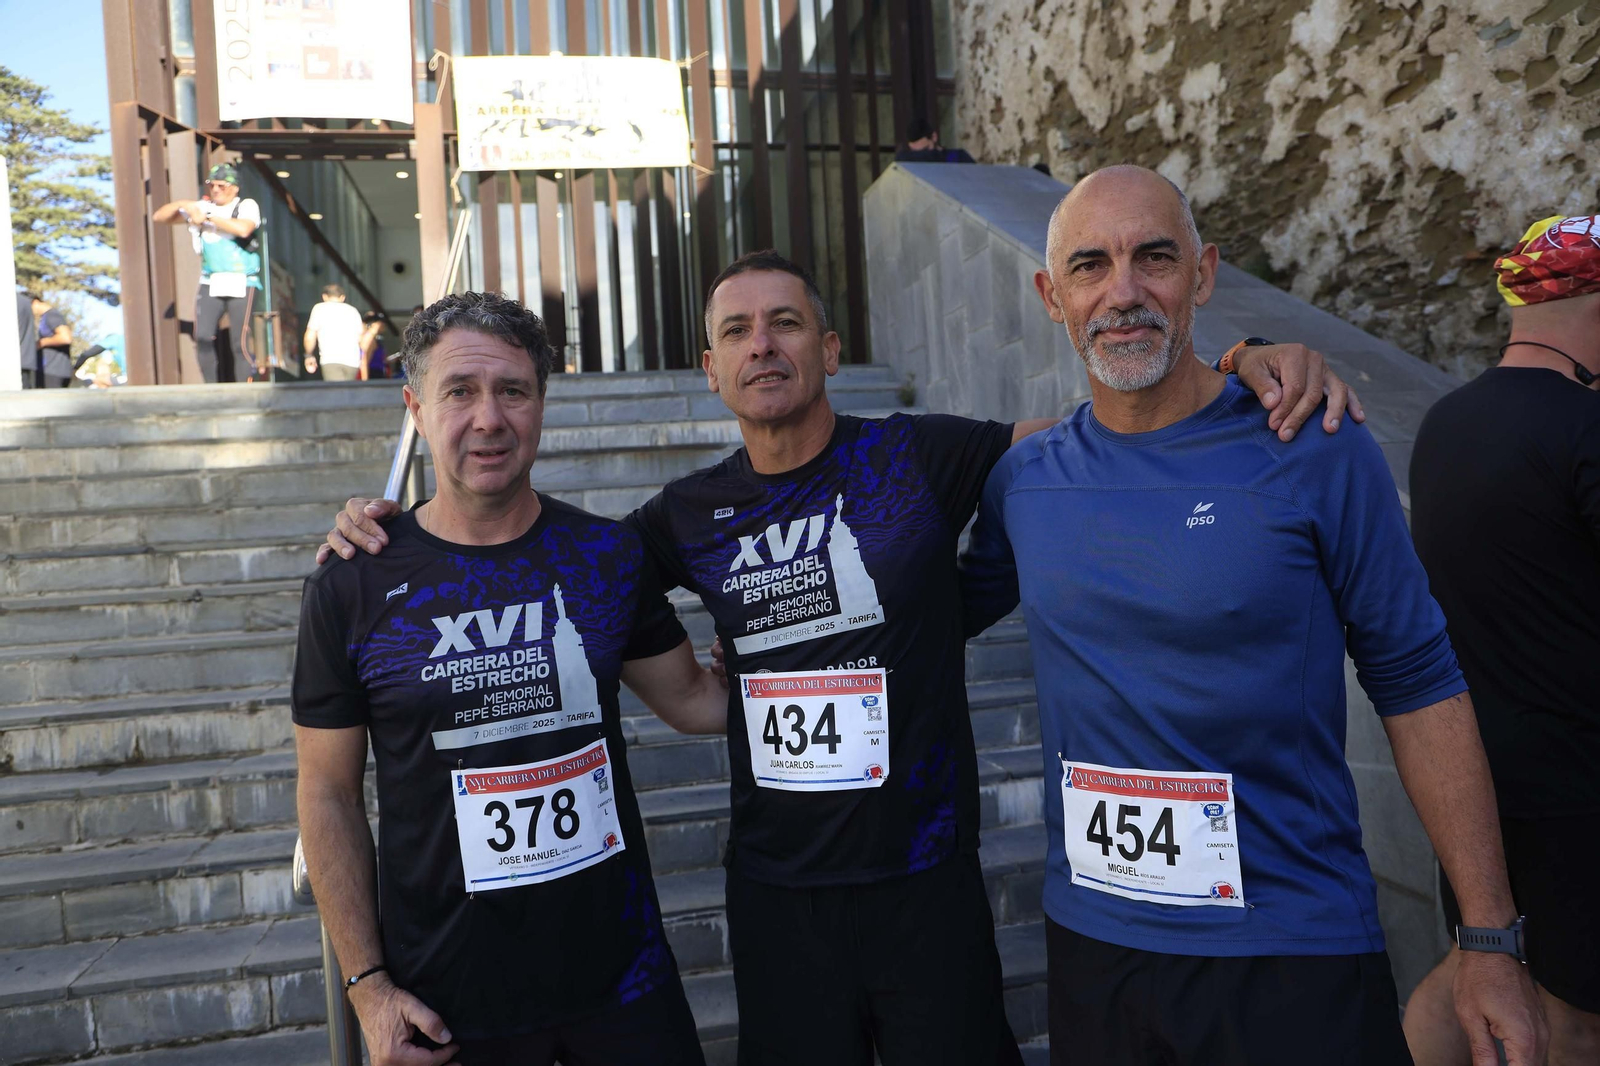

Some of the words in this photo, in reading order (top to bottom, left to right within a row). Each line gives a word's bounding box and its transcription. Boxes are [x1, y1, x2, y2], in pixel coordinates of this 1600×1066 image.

[729, 513, 826, 573] XVI
[722, 567, 791, 594] CARRERA
[793, 554, 825, 575] DEL
[743, 570, 827, 605] ESTRECHO
[746, 615, 775, 632] PEPE
[778, 601, 833, 624] SERRANO
[769, 589, 831, 615] MEMORIAL
[428, 601, 543, 659] XVI
[763, 637, 768, 645] 7
[771, 627, 812, 644] DICIEMBRE
[814, 621, 835, 633] 2025
[847, 612, 877, 625] TARIFA
[421, 652, 512, 682] CARRERA
[513, 646, 548, 667] DEL
[451, 662, 550, 694] ESTRECHO
[483, 683, 553, 706] MEMORIAL
[762, 679, 801, 691] CARRERA
[803, 679, 823, 689] DEL
[824, 677, 880, 688] ESTRECHO
[455, 706, 489, 724] PEPE
[491, 695, 554, 717] SERRANO
[473, 731, 479, 740] 7
[482, 721, 530, 738] DICIEMBRE
[532, 717, 556, 729] 2025
[566, 711, 595, 723] TARIFA
[763, 702, 842, 756] 434
[870, 738, 879, 746] M
[468, 777, 486, 788] XVI
[486, 771, 537, 787] CARRERA
[537, 767, 560, 779] DEL
[559, 750, 604, 775] ESTRECHO
[770, 760, 783, 768] JUAN
[785, 760, 814, 769] CARLOS
[1089, 773, 1135, 789] CARRERA
[1137, 780, 1158, 791] DEL
[1160, 781, 1225, 794] ESTRECHO
[483, 788, 580, 853] 378
[604, 808, 609, 816] L
[1086, 800, 1181, 866] 454
[498, 856, 522, 866] JOSE
[523, 848, 561, 863] MANUEL
[1107, 862, 1139, 877] MIGUEL
[1218, 852, 1224, 860] L
